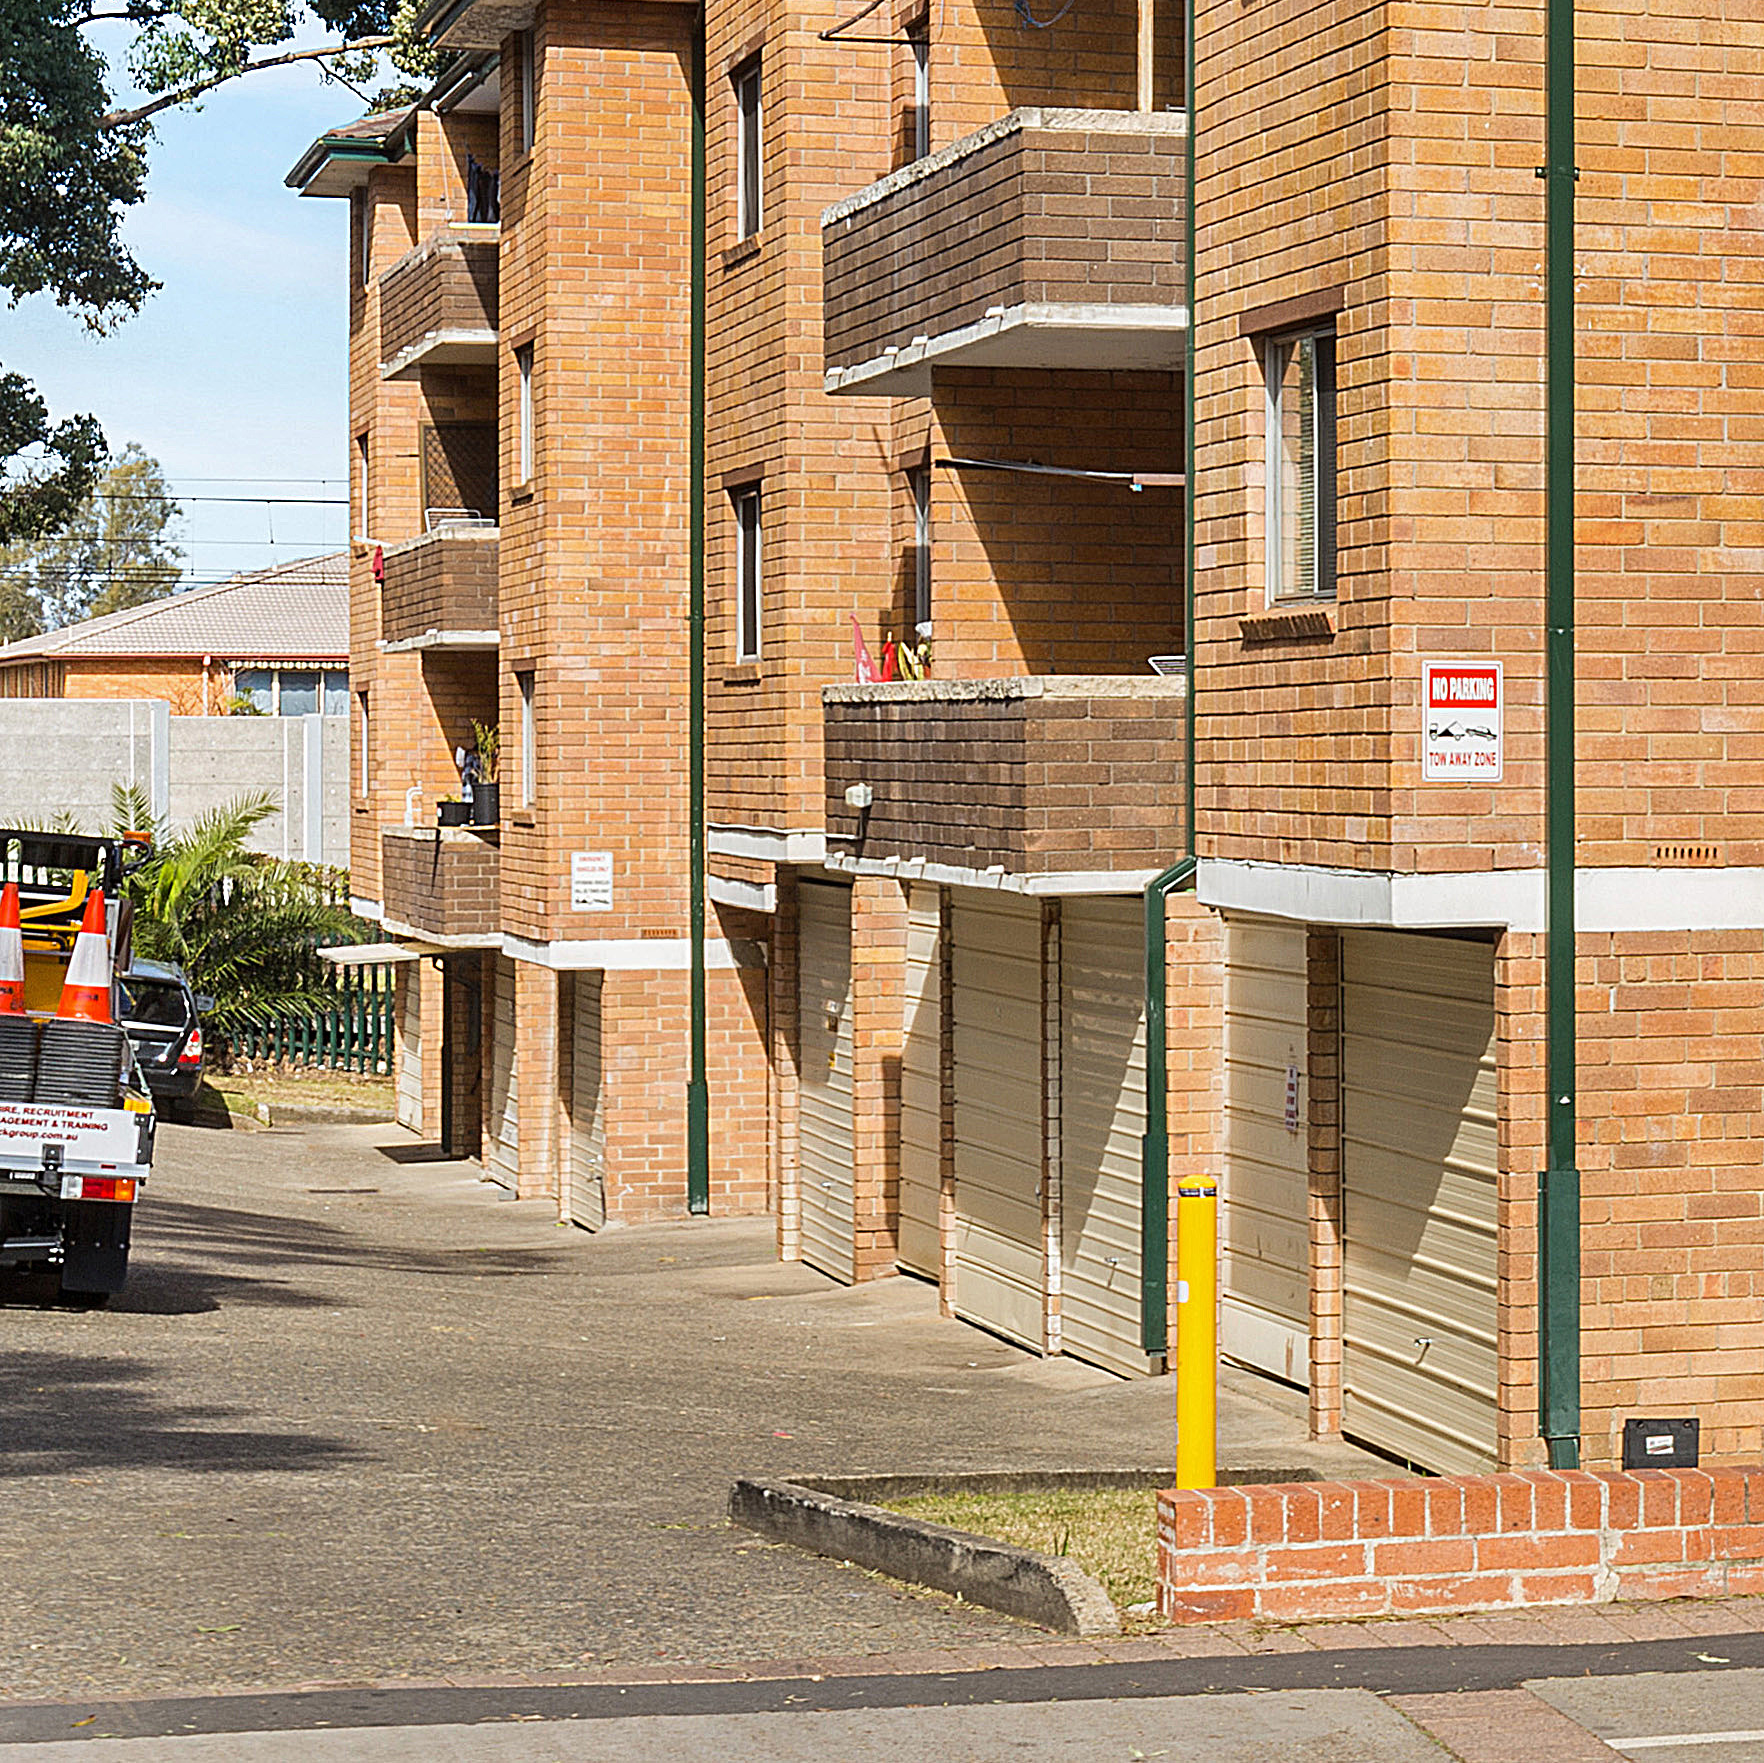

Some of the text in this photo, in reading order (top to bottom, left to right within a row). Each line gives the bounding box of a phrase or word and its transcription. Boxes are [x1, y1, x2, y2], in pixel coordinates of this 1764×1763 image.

[1432, 677, 1495, 701] NO PARKING
[1429, 751, 1496, 767] TOW AWAY ZONE
[23, 1107, 94, 1119] RECRUITMENT
[51, 1119, 58, 1127] &
[61, 1120, 108, 1131] TRAINING
